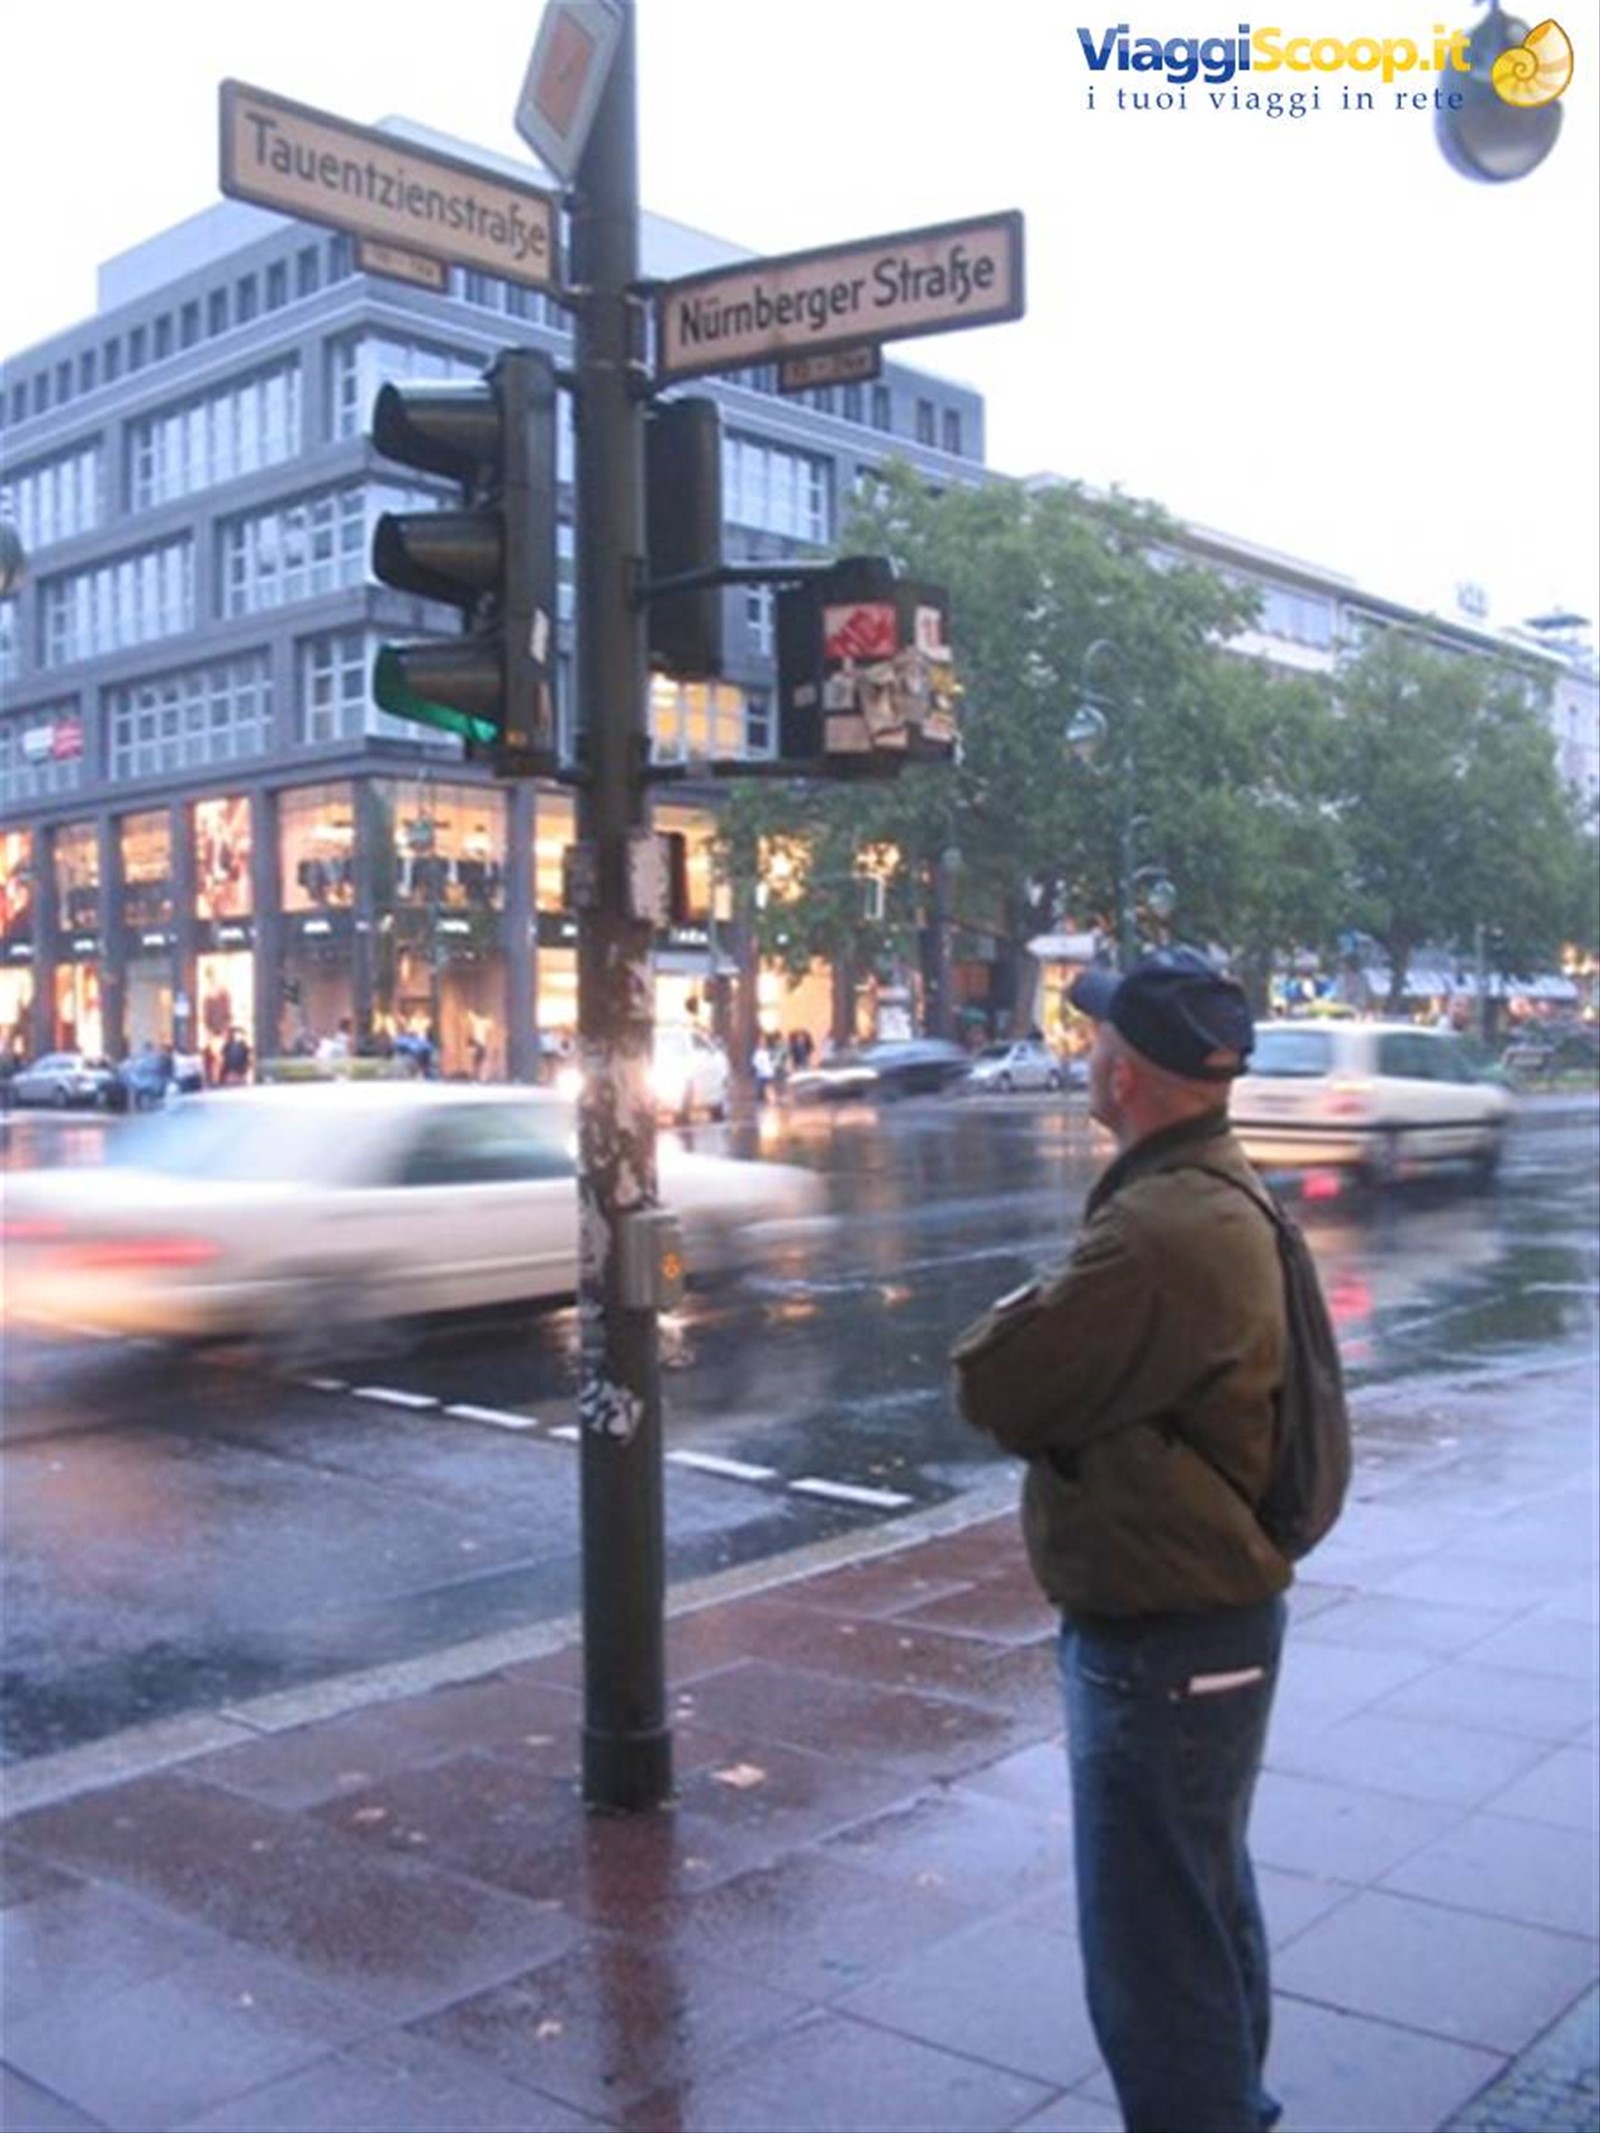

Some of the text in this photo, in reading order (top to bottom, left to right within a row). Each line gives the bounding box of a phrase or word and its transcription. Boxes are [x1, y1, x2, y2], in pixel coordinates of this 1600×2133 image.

[245, 112, 546, 260] Tauentzienstraße
[680, 244, 995, 346] Nürnberger Straße
